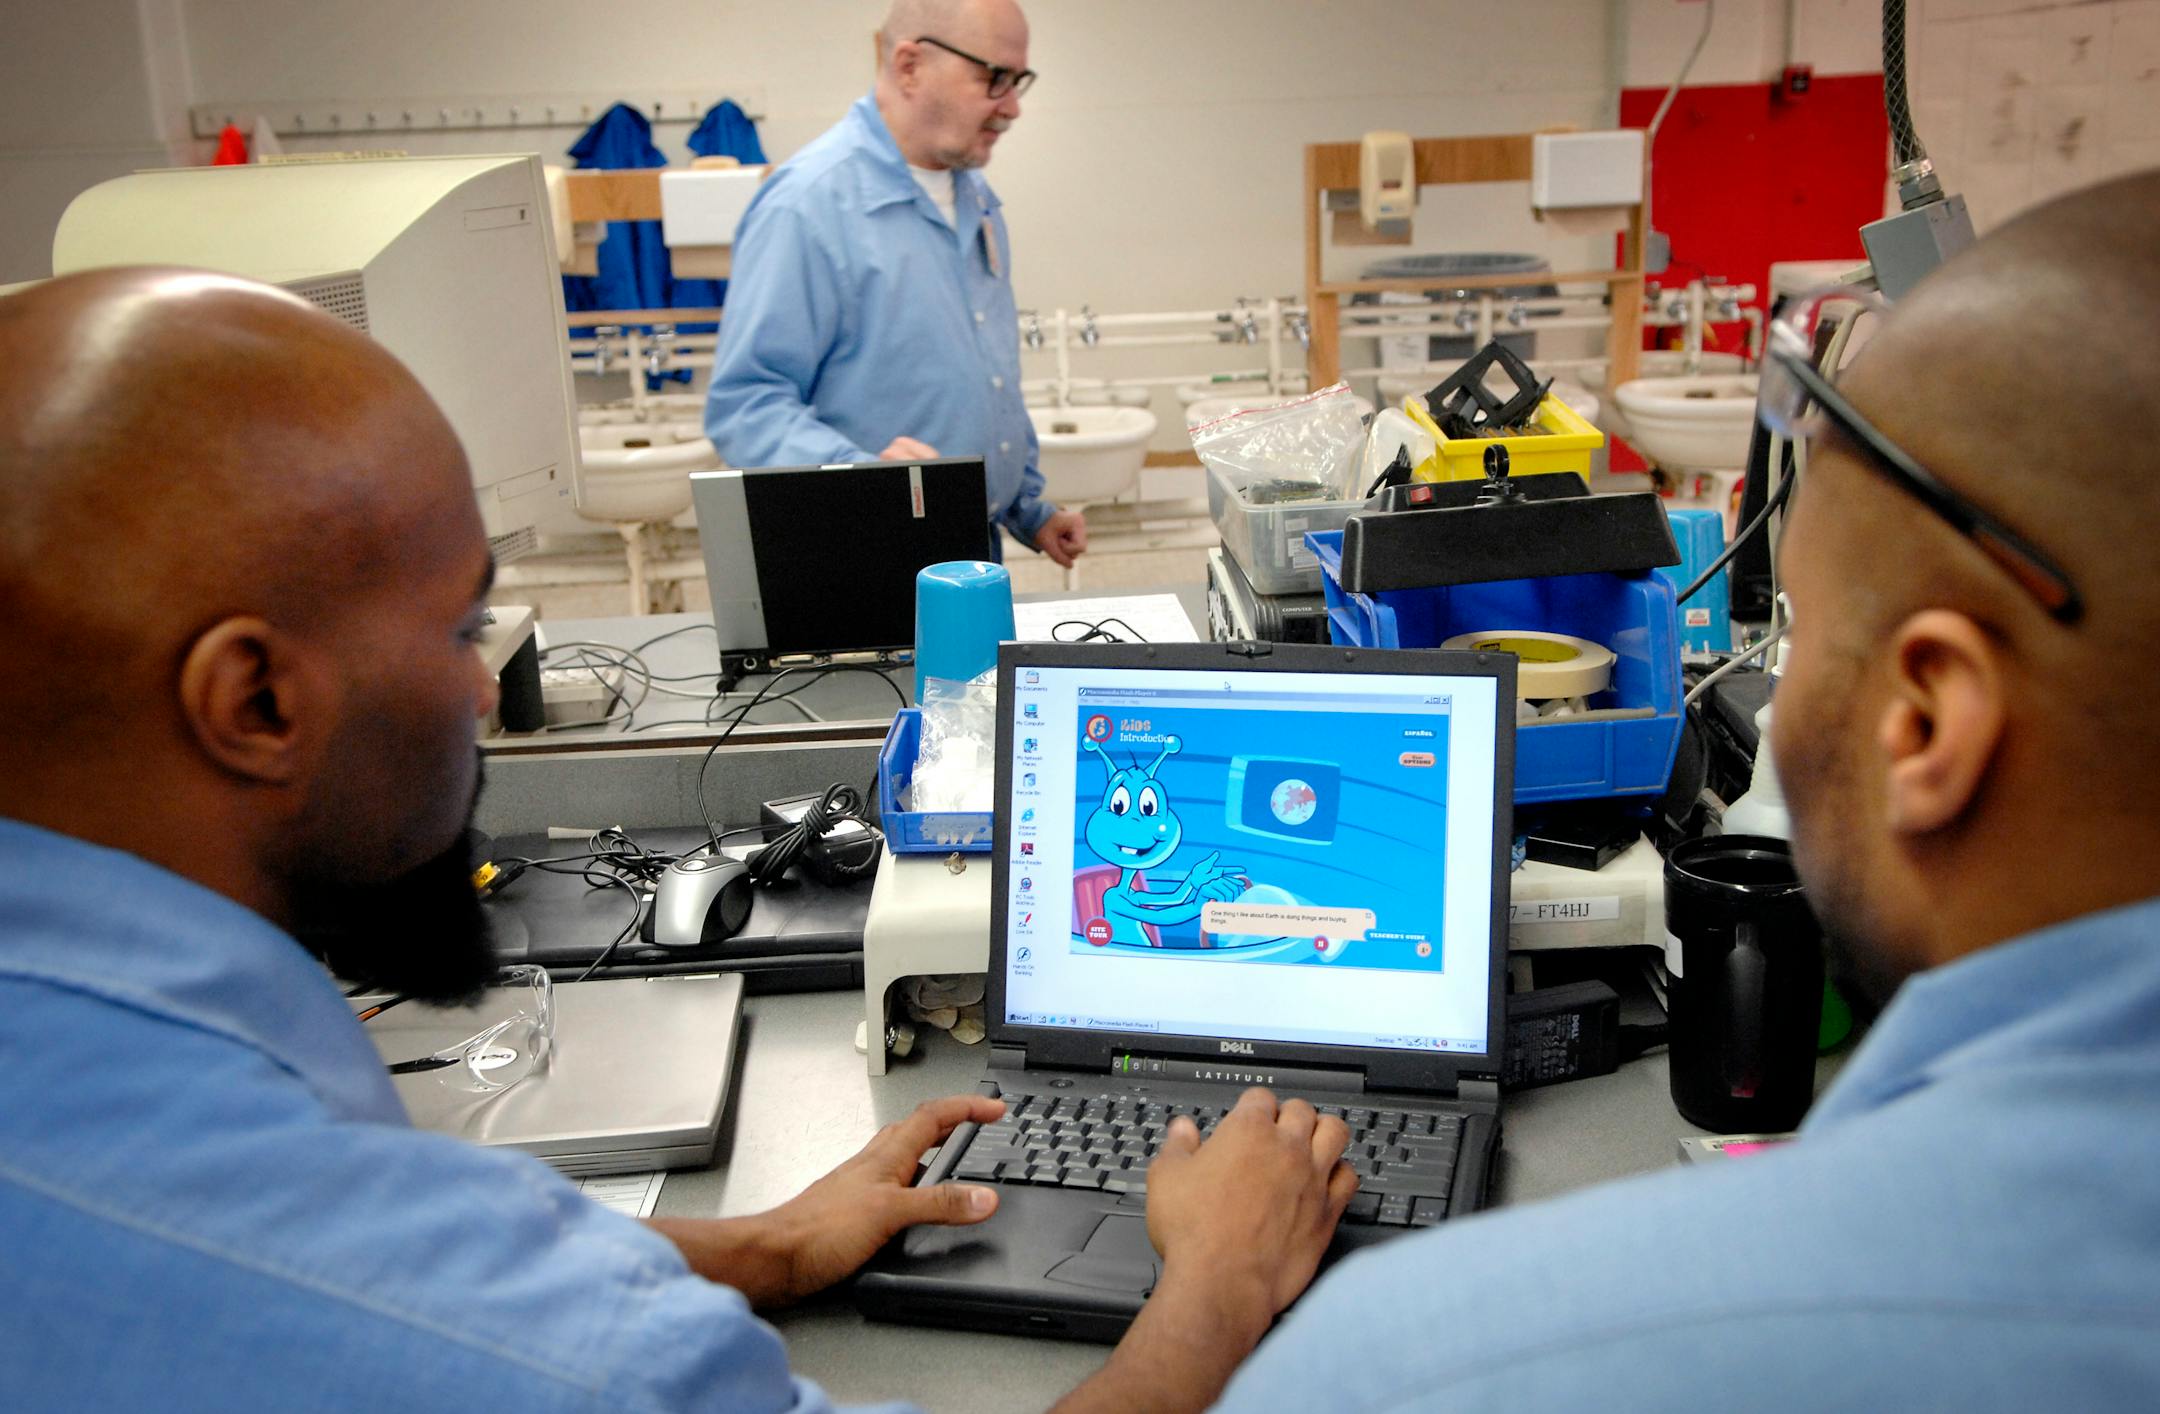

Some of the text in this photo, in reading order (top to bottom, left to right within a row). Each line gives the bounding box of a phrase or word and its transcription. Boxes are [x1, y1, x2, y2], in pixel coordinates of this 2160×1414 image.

[1120, 733, 1174, 743] Introductio
[1538, 903, 1591, 919] FT4HJ
[1571, 1014, 1580, 1040] DELL
[1220, 1041, 1254, 1054] DELL
[1195, 1071, 1274, 1083] LATITUDE
